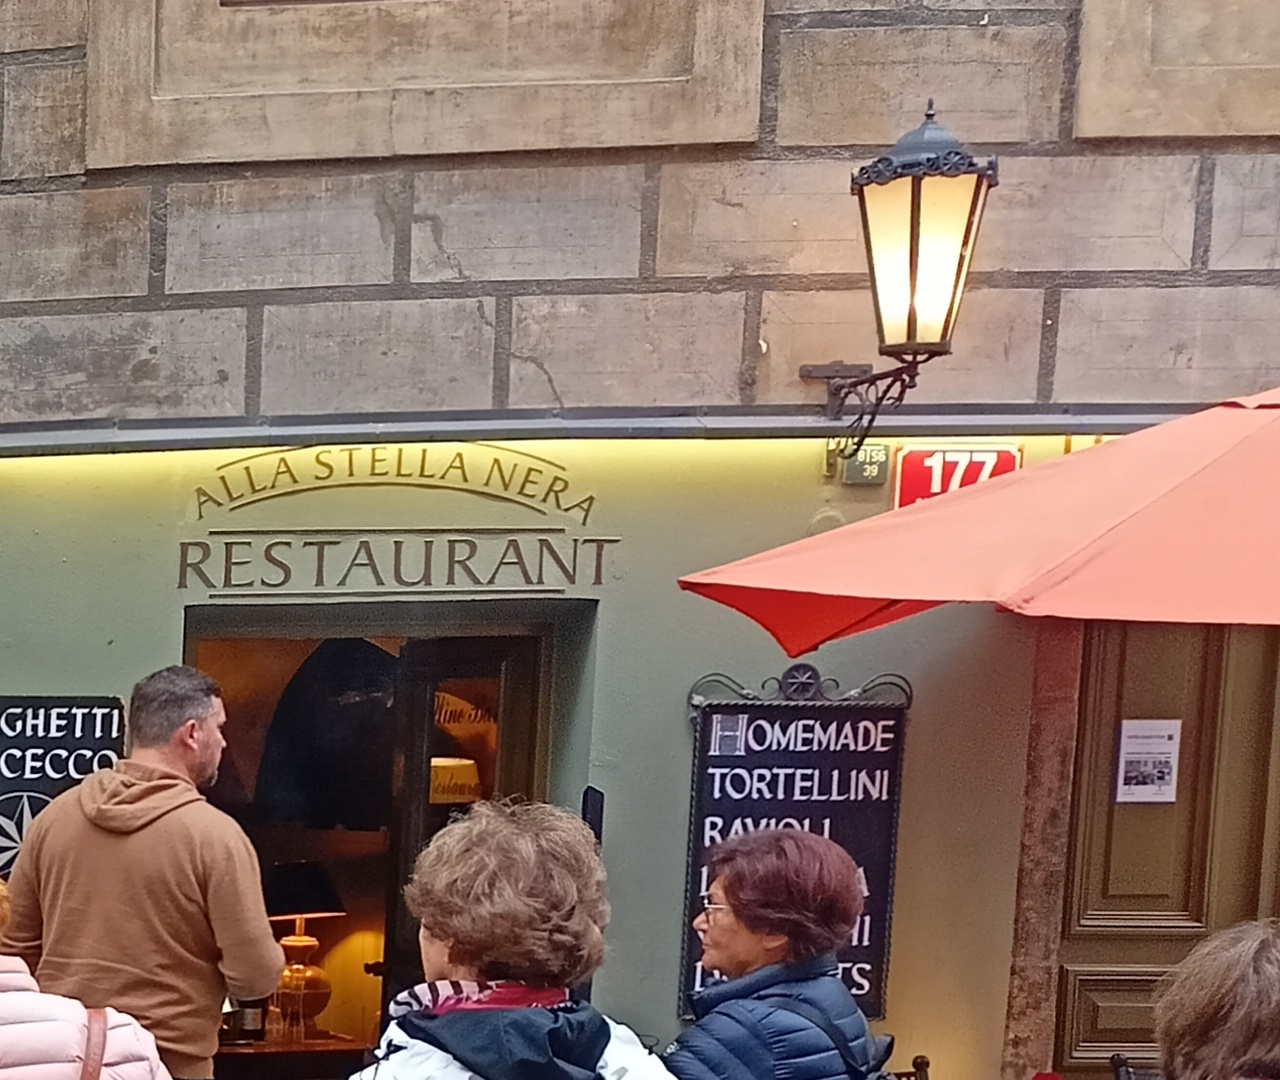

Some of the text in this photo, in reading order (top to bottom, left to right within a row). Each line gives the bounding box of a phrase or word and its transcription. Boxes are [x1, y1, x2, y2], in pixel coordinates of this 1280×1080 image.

[195, 447, 596, 527] ALLA STELLA NERA
[924, 452, 998, 494] 177
[176, 536, 622, 589] RESTAURANT
[708, 713, 895, 757] HOMEMADE
[0, 748, 120, 780] CECCO
[707, 766, 890, 802] TORTELLINI
